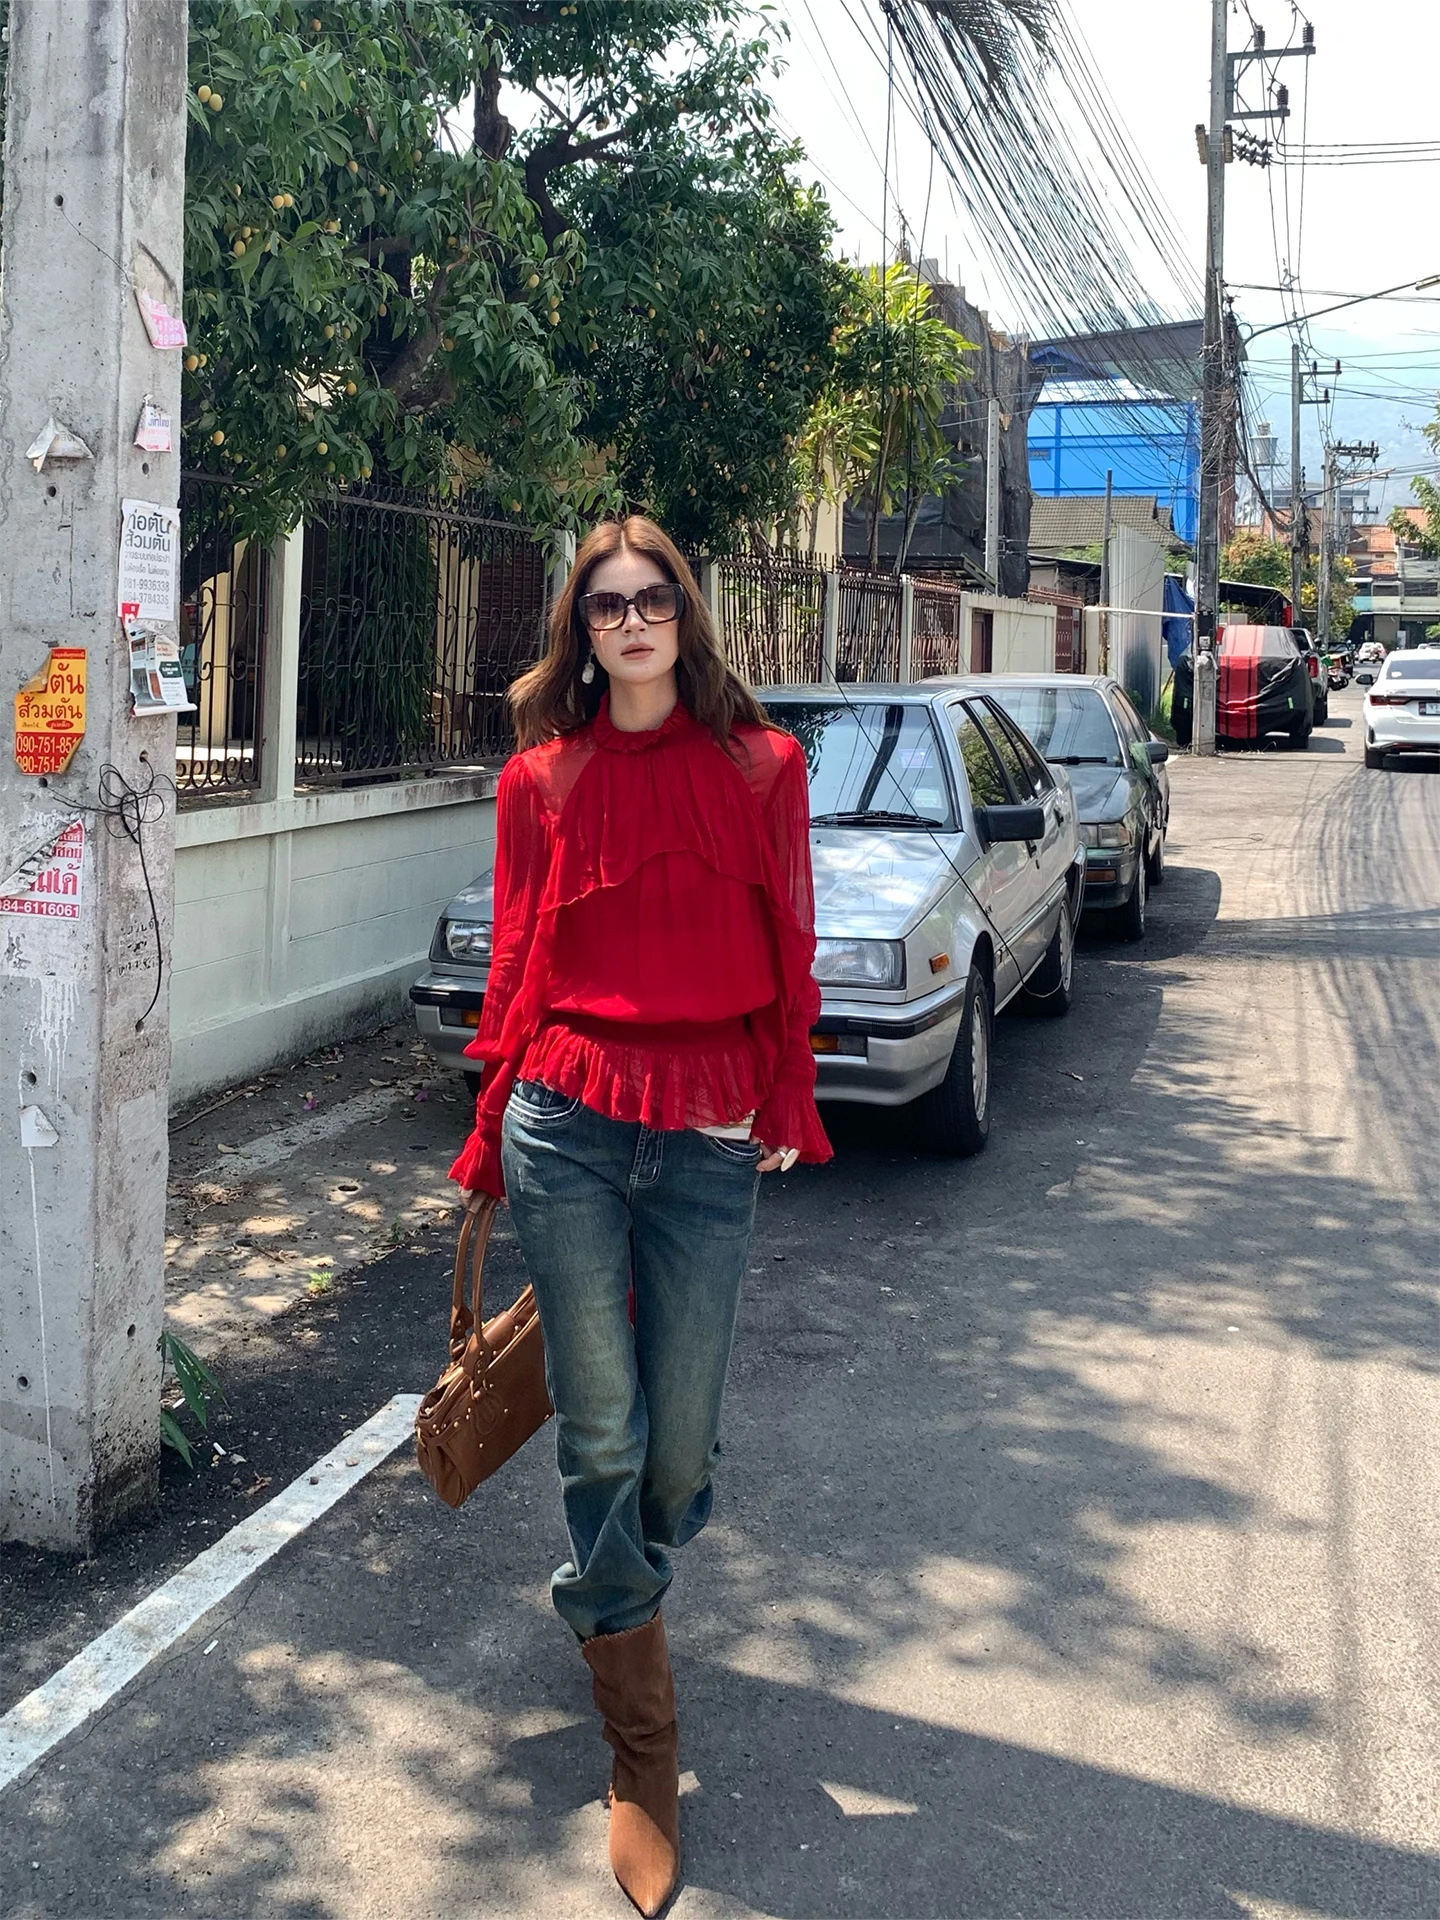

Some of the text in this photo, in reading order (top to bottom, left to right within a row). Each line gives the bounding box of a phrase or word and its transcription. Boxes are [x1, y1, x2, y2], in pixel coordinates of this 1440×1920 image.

[124, 529, 171, 553] ส้วมตัน
[17, 695, 84, 720] ส้วมตัน
